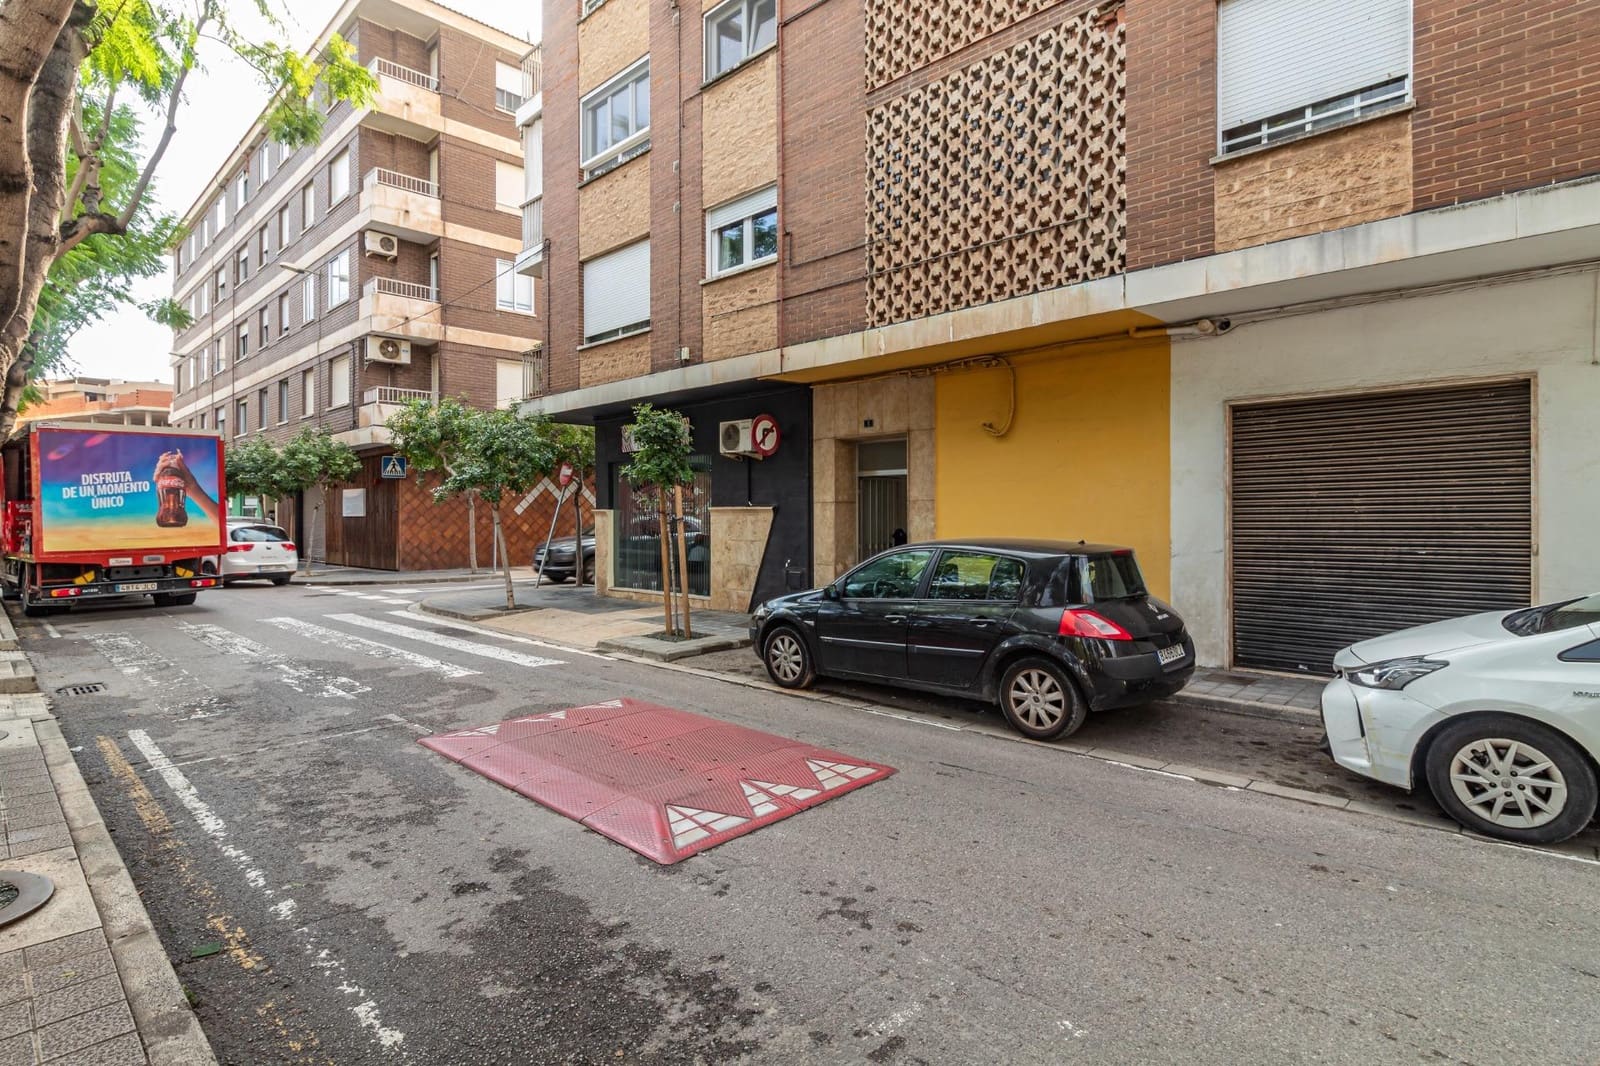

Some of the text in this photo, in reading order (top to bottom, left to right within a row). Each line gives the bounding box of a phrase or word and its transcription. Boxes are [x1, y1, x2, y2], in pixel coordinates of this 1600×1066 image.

[82, 472, 132, 485] DISFRUTA
[62, 480, 150, 499] DE UN MOMENTO
[92, 493, 124, 509] ÚNICO
